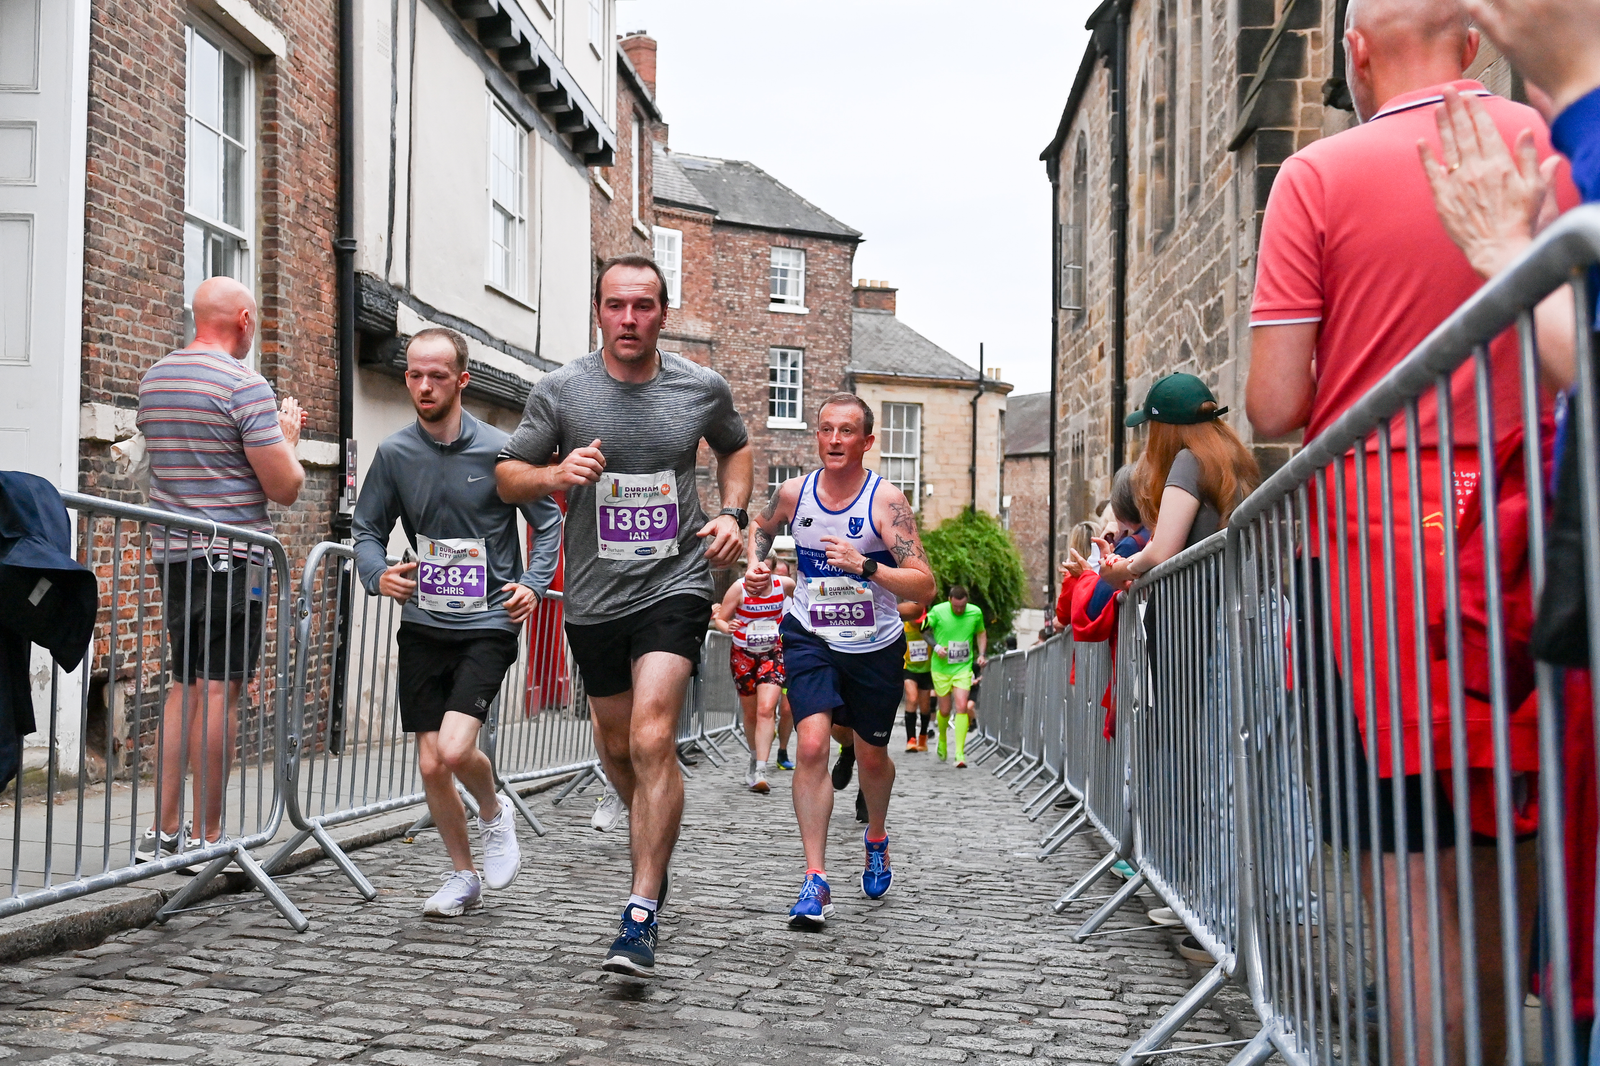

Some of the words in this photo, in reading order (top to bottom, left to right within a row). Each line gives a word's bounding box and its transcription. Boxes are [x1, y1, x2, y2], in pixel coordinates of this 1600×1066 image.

[606, 507, 668, 531] 1369
[629, 532, 649, 540] IAN
[422, 564, 479, 587] 2384
[435, 586, 465, 595] CHRIS
[815, 603, 866, 621] 1536
[748, 634, 776, 643] 2393
